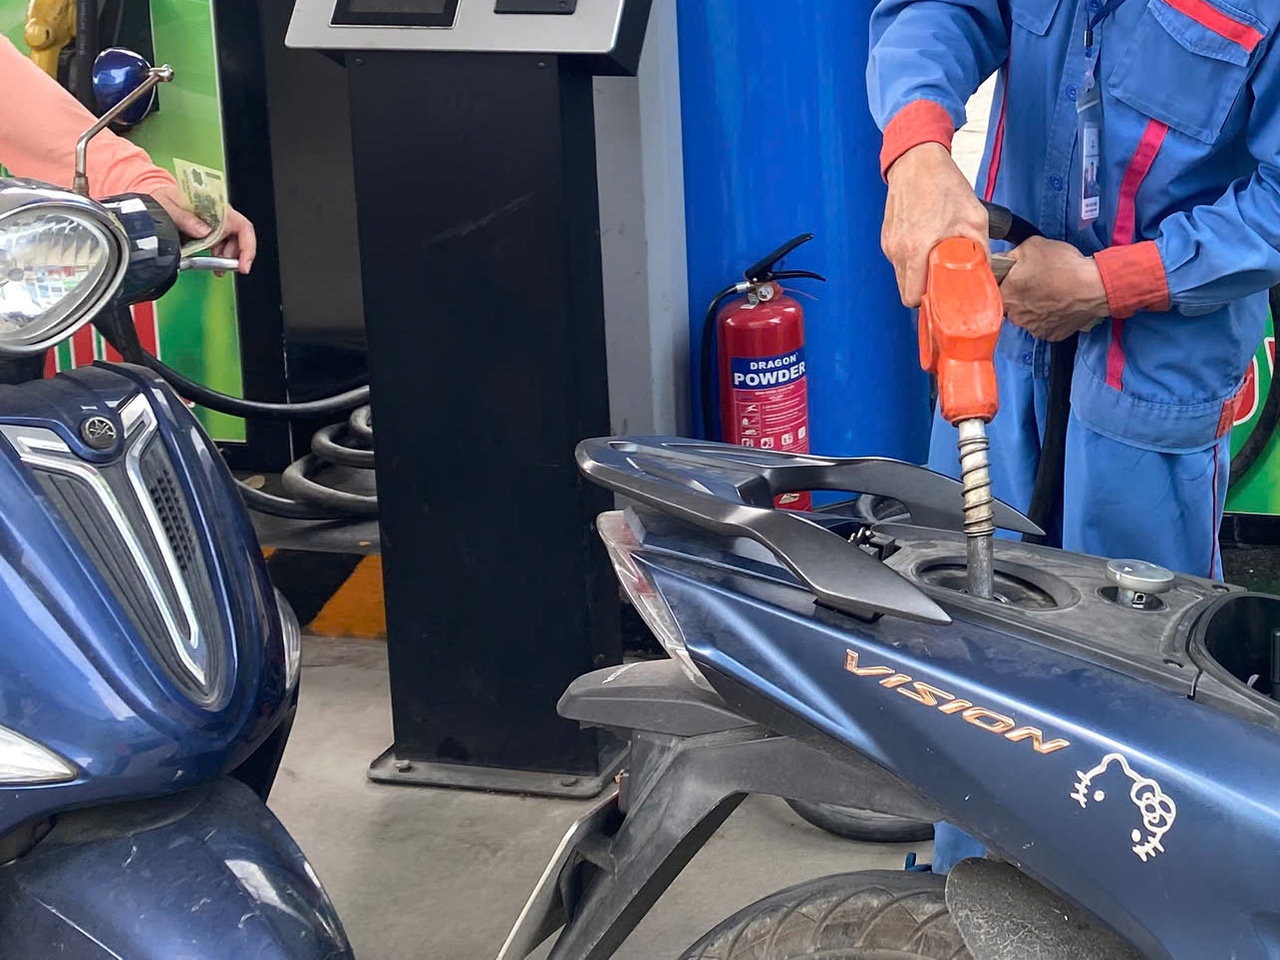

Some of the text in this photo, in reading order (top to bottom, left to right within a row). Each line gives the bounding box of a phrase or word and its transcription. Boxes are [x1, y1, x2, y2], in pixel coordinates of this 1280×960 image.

[734, 360, 806, 386] POWDER
[750, 354, 797, 370] DRAGON
[845, 648, 1071, 755] VISION
